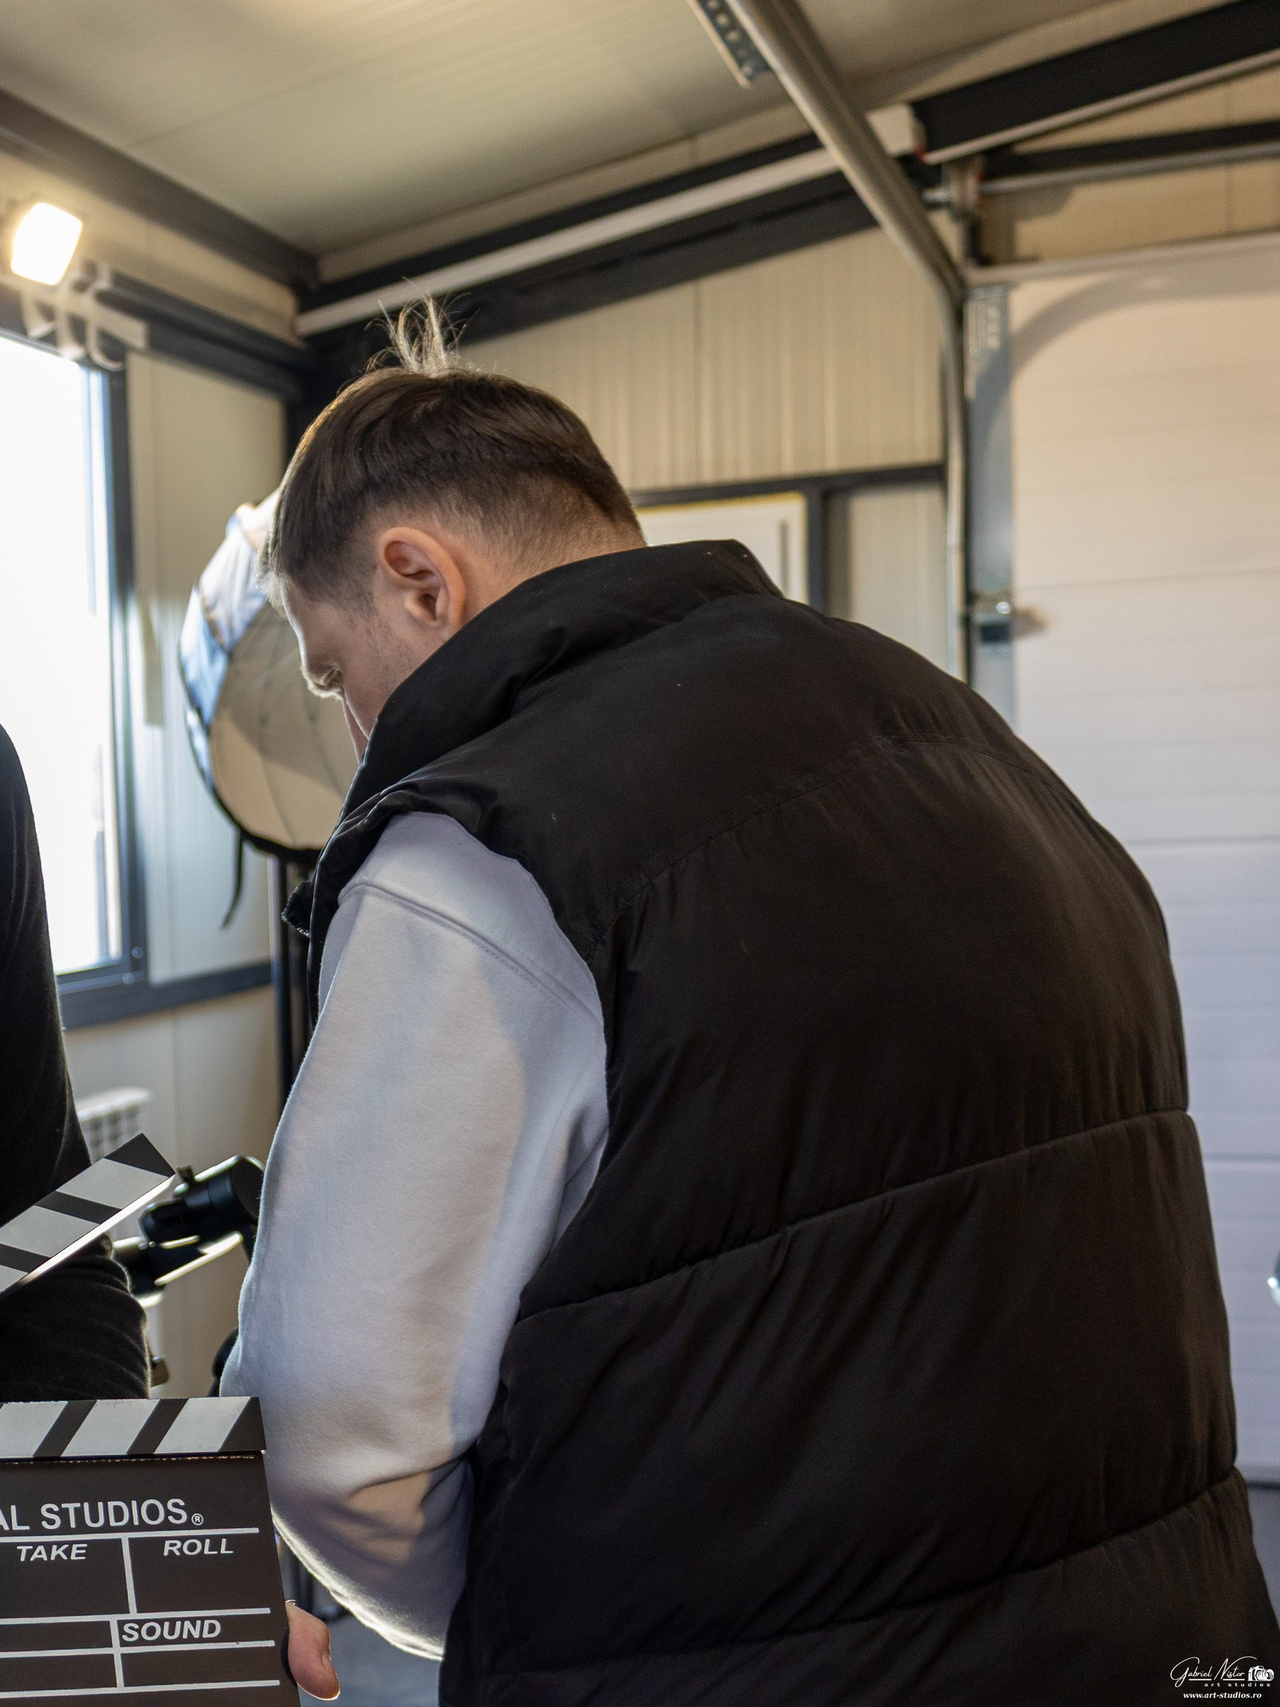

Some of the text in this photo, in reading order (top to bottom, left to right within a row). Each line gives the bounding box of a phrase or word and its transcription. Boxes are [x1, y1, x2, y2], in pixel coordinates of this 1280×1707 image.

[17, 1543, 89, 1563] TAKE
[163, 1538, 235, 1557] ROLL
[122, 1618, 222, 1643] SOUND
